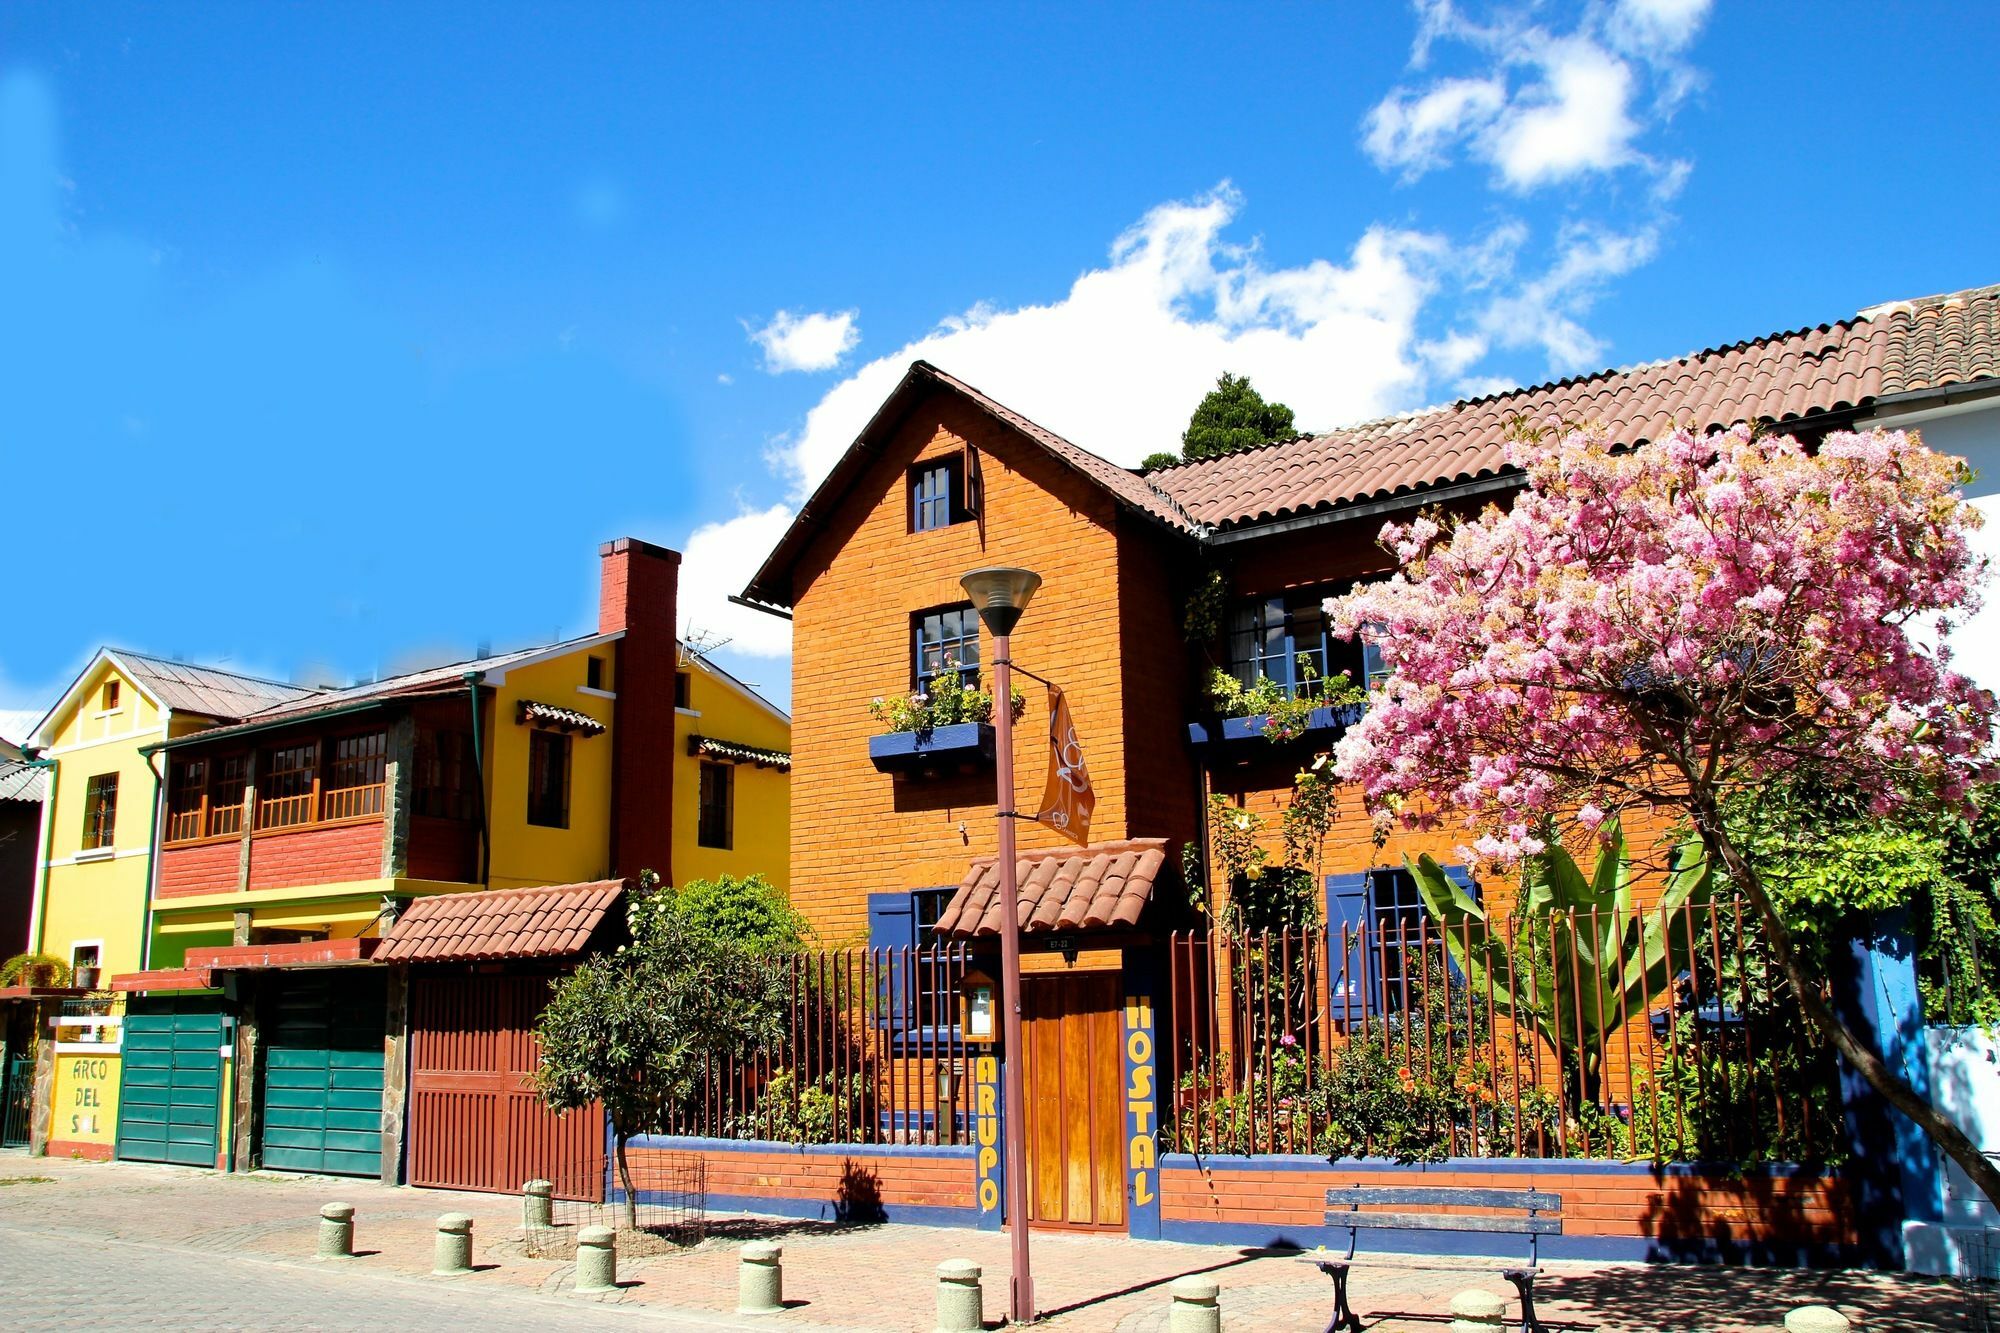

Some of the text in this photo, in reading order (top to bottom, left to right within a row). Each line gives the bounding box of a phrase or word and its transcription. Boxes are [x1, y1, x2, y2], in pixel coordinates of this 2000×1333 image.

[73, 1059, 107, 1081] ARCO
[75, 1088, 100, 1108] DEL
[1126, 996, 1155, 1207] HOSTAL
[976, 1056, 998, 1210] ARUPO
